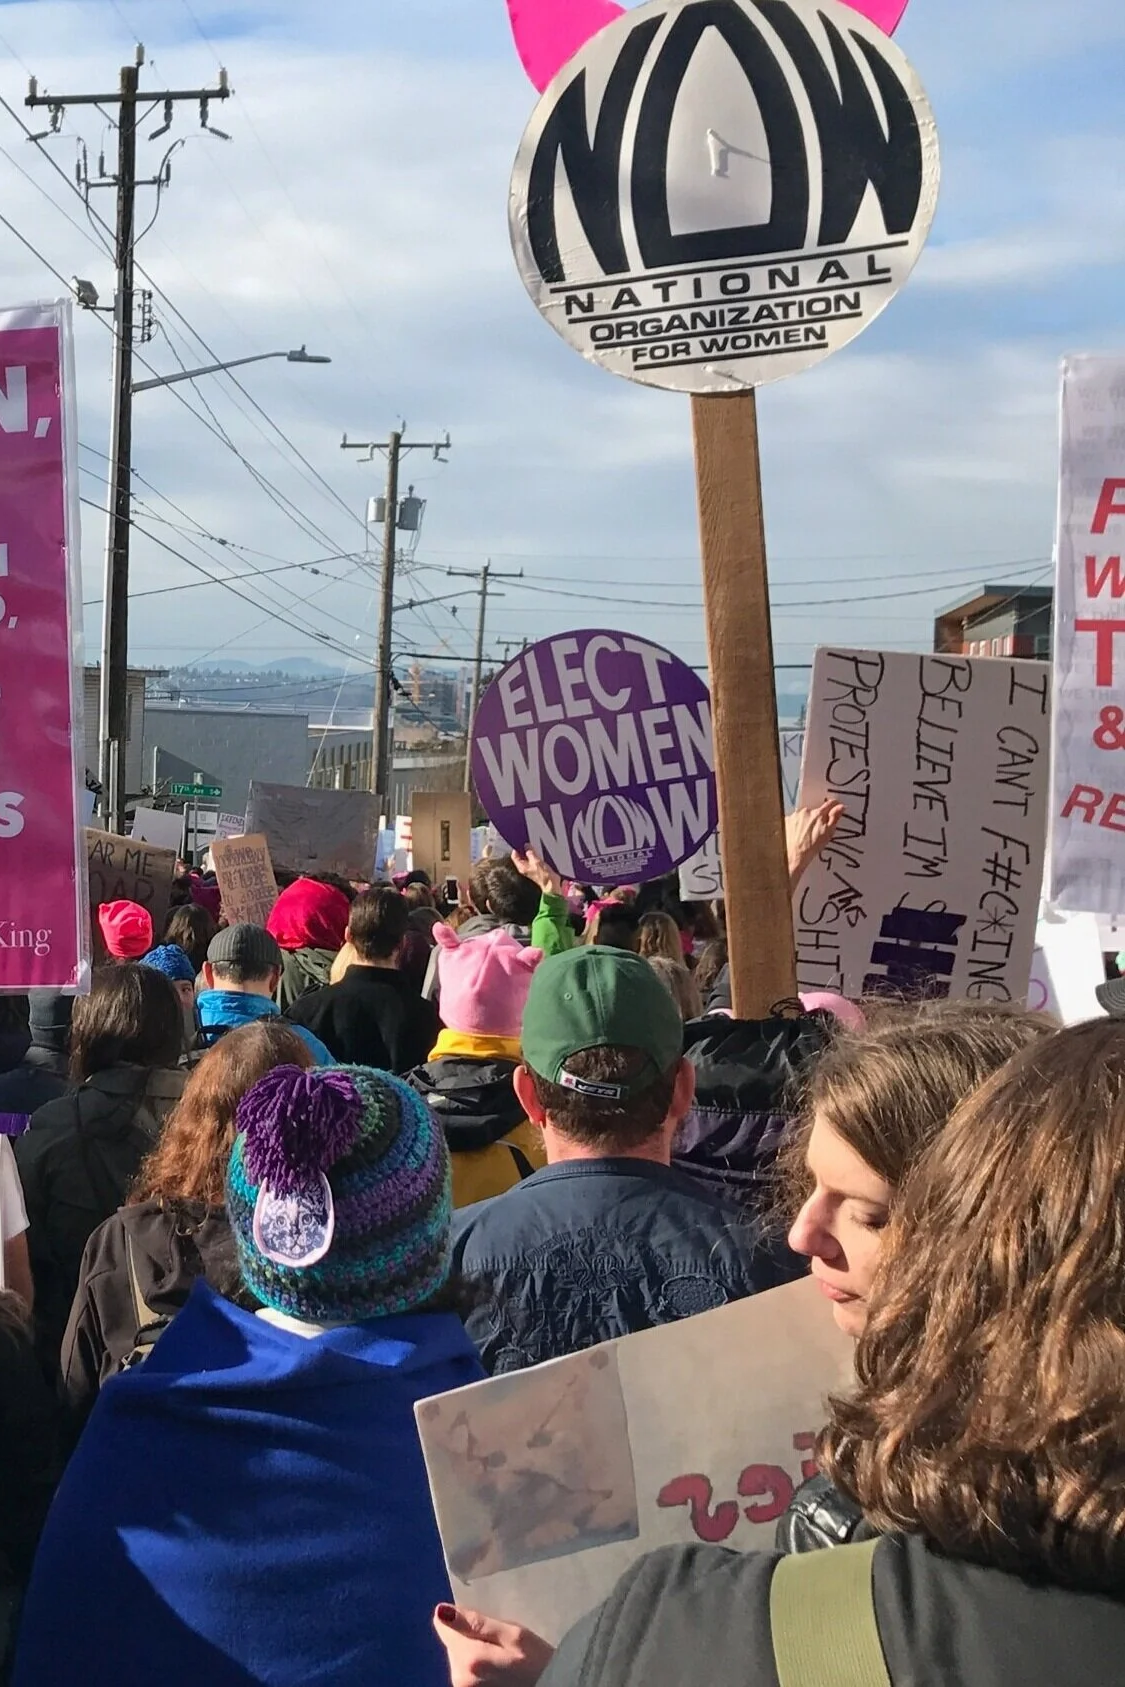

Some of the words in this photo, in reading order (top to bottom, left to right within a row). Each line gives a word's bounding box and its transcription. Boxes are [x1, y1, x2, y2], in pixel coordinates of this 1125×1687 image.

[527, 0, 922, 283] NOW
[565, 254, 891, 315] NATIONAL
[590, 291, 861, 342] ORGANIZATION
[632, 342, 691, 362] FOR
[699, 325, 826, 354] WOMEN
[497, 634, 673, 729] ELECT
[1008, 665, 1049, 716] I
[476, 700, 716, 808] WOMEN
[818, 652, 885, 871] PROTESTING
[912, 655, 973, 822] BELIEVE
[993, 725, 1040, 818] CAN'T
[123, 847, 156, 878] ME
[795, 886, 847, 998] SHIT
